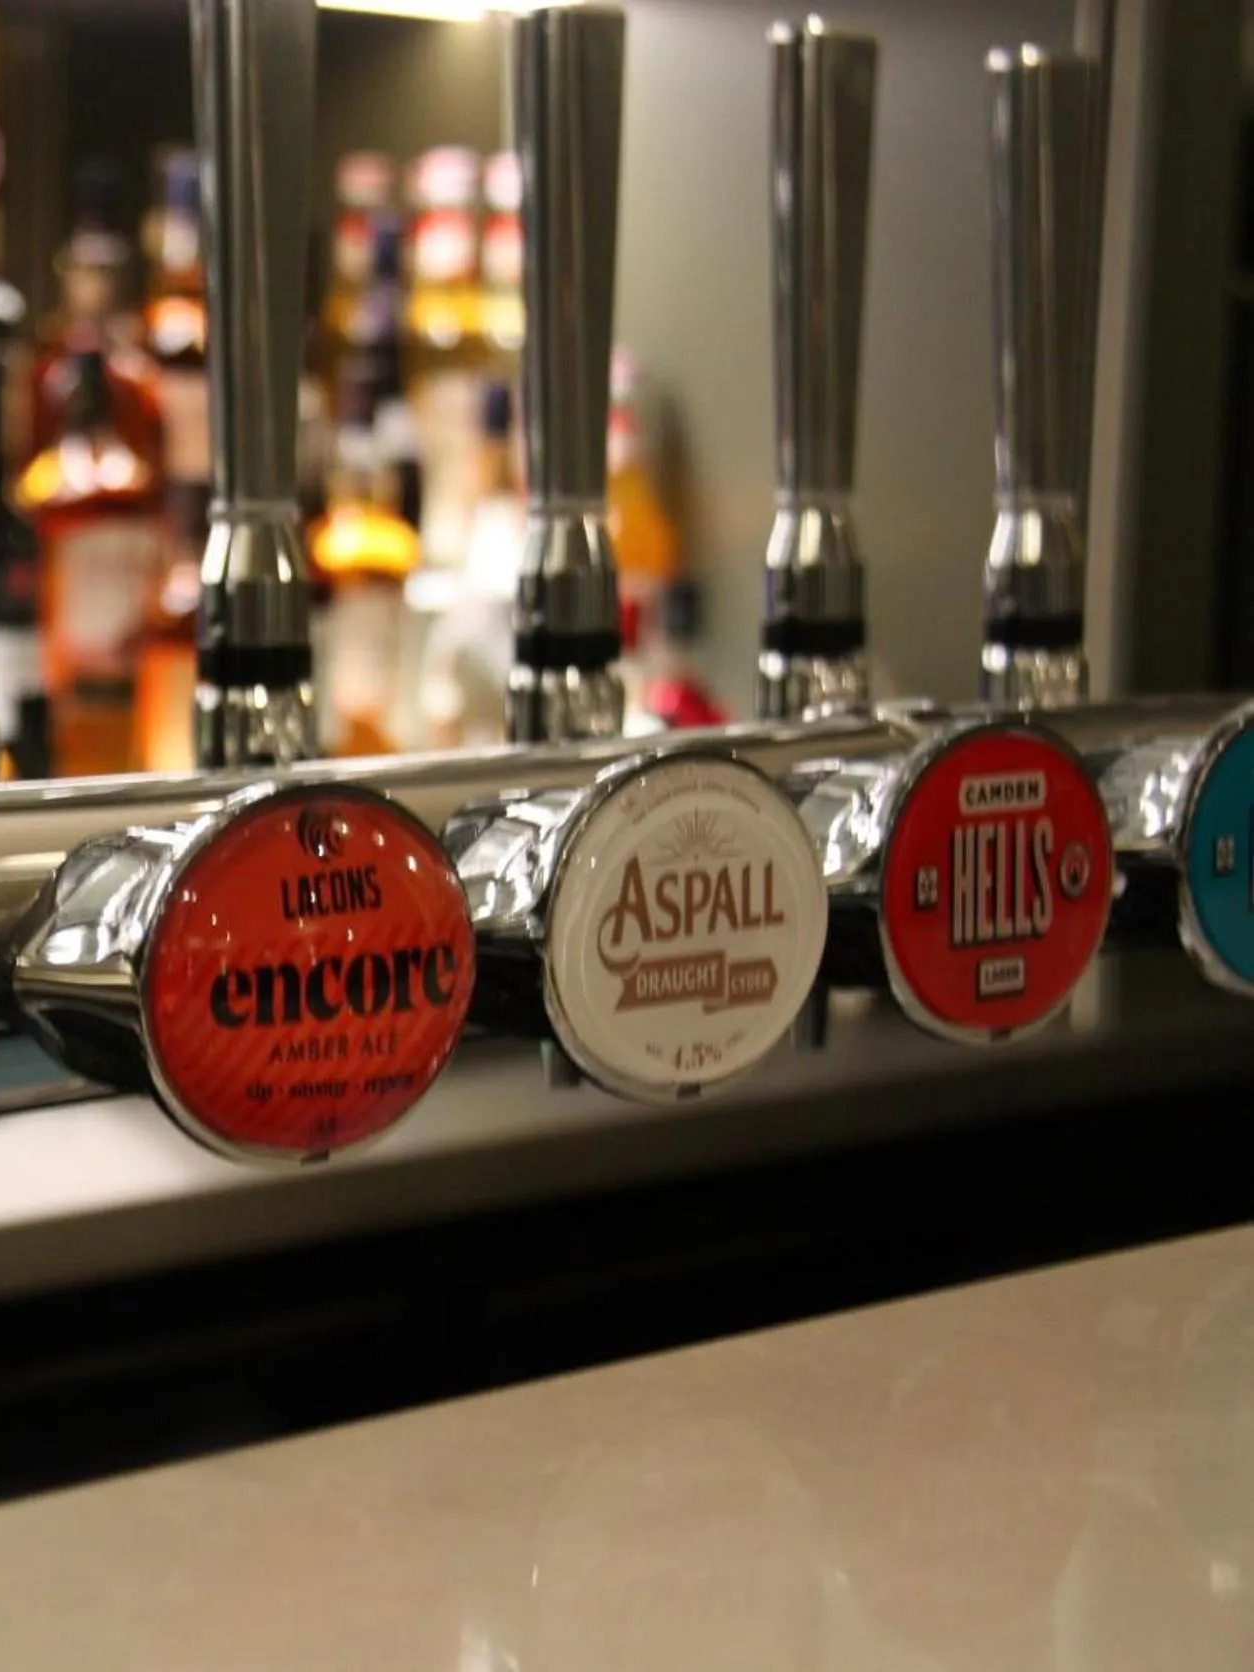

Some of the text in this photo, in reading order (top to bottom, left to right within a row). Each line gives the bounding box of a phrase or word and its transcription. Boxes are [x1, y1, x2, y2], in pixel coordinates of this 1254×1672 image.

[965, 778, 1040, 807] CAMDEN
[281, 866, 382, 920] LACONS
[952, 815, 1054, 946] HELLS
[598, 855, 784, 972] ASPALL
[210, 940, 456, 1030] encore
[634, 961, 720, 1000] DRAUGHT
[269, 1030, 399, 1066] AMBER ALE
